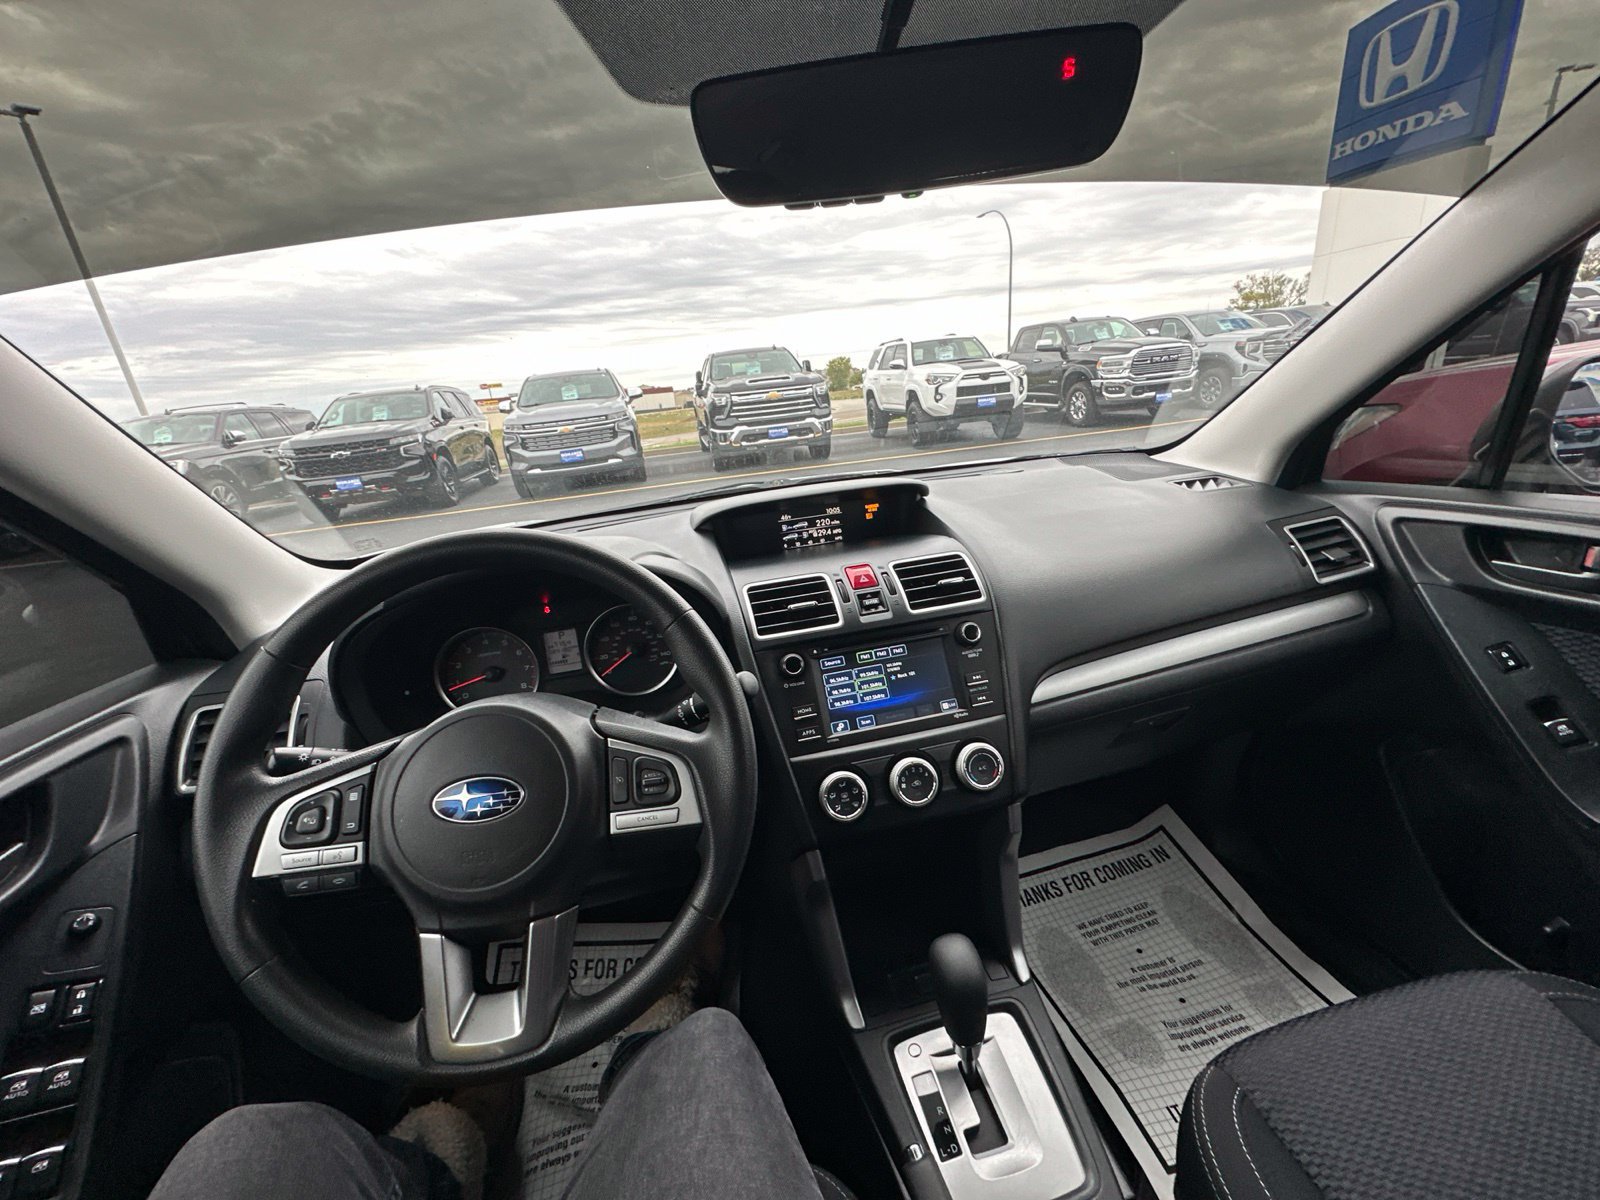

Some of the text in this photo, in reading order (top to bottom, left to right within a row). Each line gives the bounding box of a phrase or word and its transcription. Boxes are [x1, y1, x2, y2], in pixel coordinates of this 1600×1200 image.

[1332, 101, 1470, 160] HONDA
[815, 518, 831, 527] 220
[558, 631, 565, 639] P
[824, 659, 841, 667] Source
[291, 856, 312, 864] Source
[1061, 871, 1096, 894] FOR
[1094, 853, 1152, 884] COMING
[1150, 845, 1171, 864] IN
[1076, 901, 1149, 930] WE HAVE TRIED TO KEEP
[1081, 909, 1158, 940] YOUR CARPETING CLEAN
[1090, 917, 1160, 947] WITH THIS PAPER MAT
[584, 958, 618, 979] FOR
[1116, 959, 1204, 989] the most important person
[1137, 960, 1168, 972] customer
[1158, 978, 1179, 988] world
[1160, 1004, 1233, 1029] Your suggestions for
[1167, 1013, 1246, 1040] improving our service
[1178, 1044, 1192, 1052] are
[1190, 1035, 1219, 1050] always
[47, 1080, 72, 1091] AUTO
[571, 1083, 600, 1093] custom
[3, 1090, 29, 1101] AUTO
[937, 1106, 944, 1116] R
[552, 1122, 586, 1139] suggest
[944, 1125, 951, 1135] N
[540, 1152, 572, 1170] always
